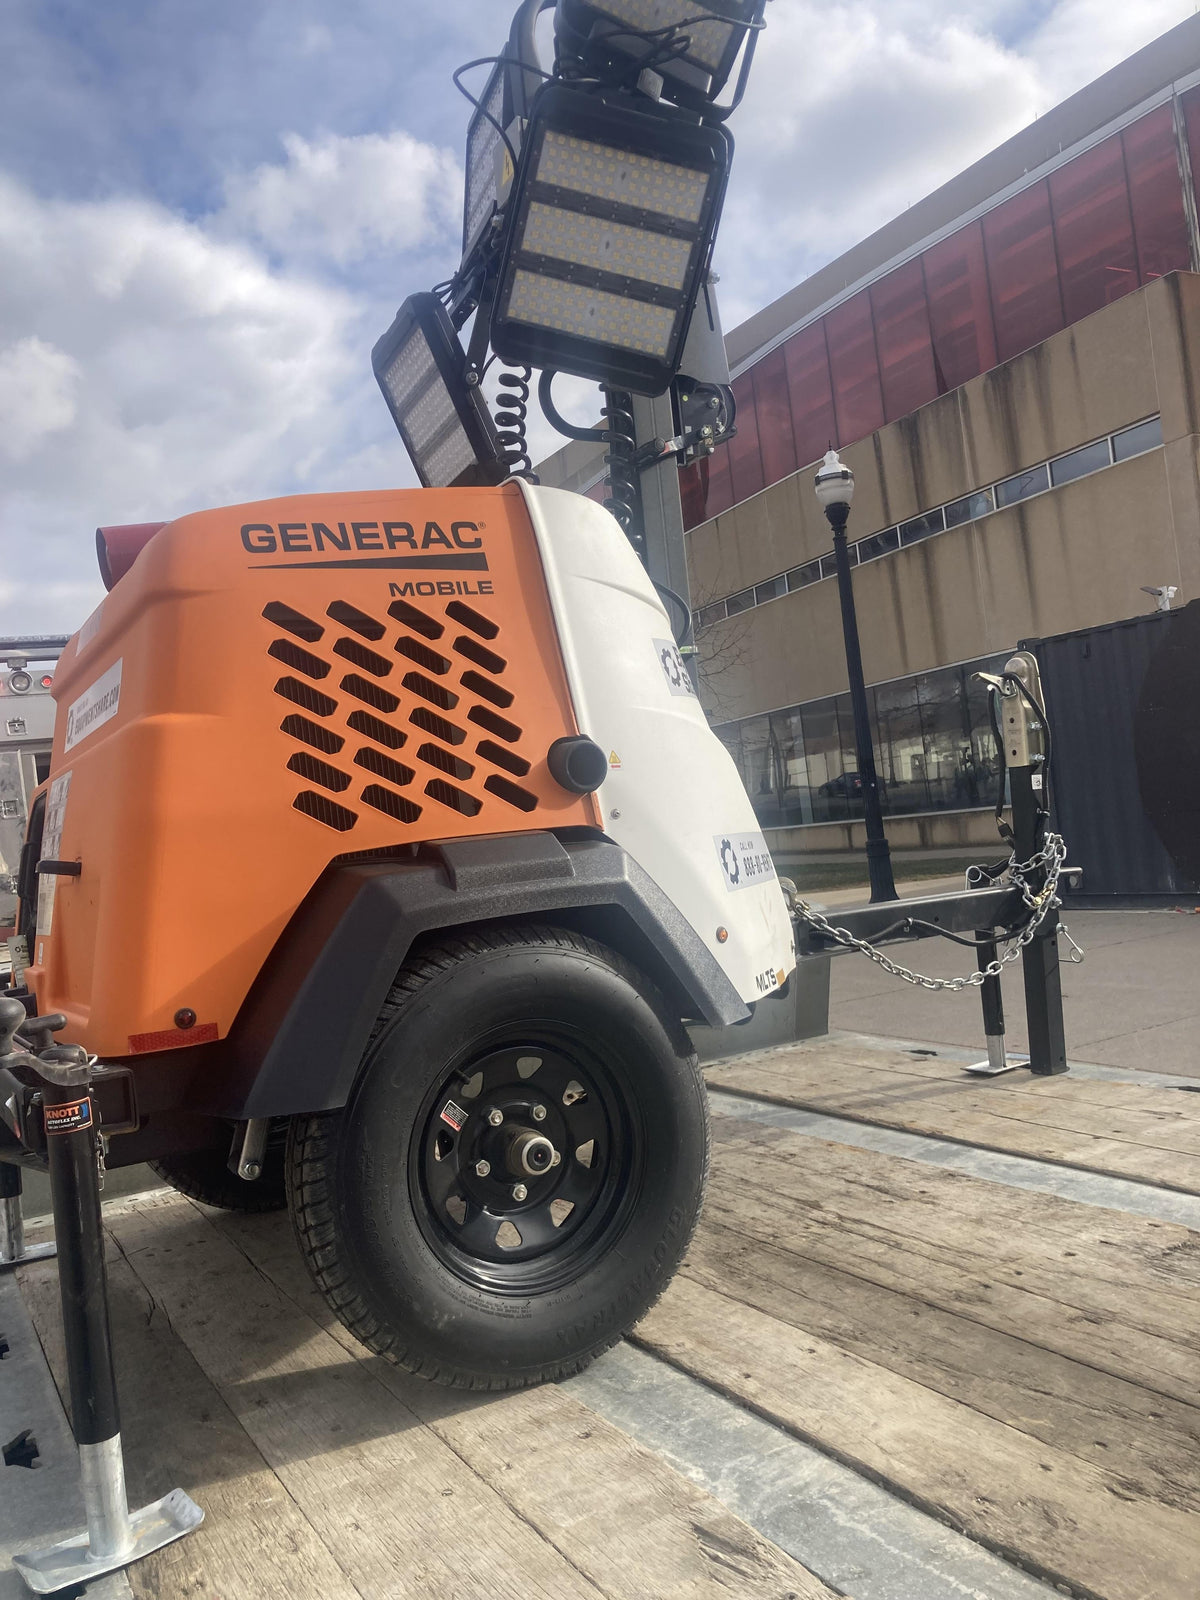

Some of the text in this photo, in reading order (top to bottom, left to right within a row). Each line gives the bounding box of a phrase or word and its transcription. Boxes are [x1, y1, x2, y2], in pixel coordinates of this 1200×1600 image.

[240, 521, 483, 553] GENERAC
[388, 581, 494, 597] MOBILE
[755, 967, 777, 992] MLTS
[46, 1106, 80, 1118] KNOTT
